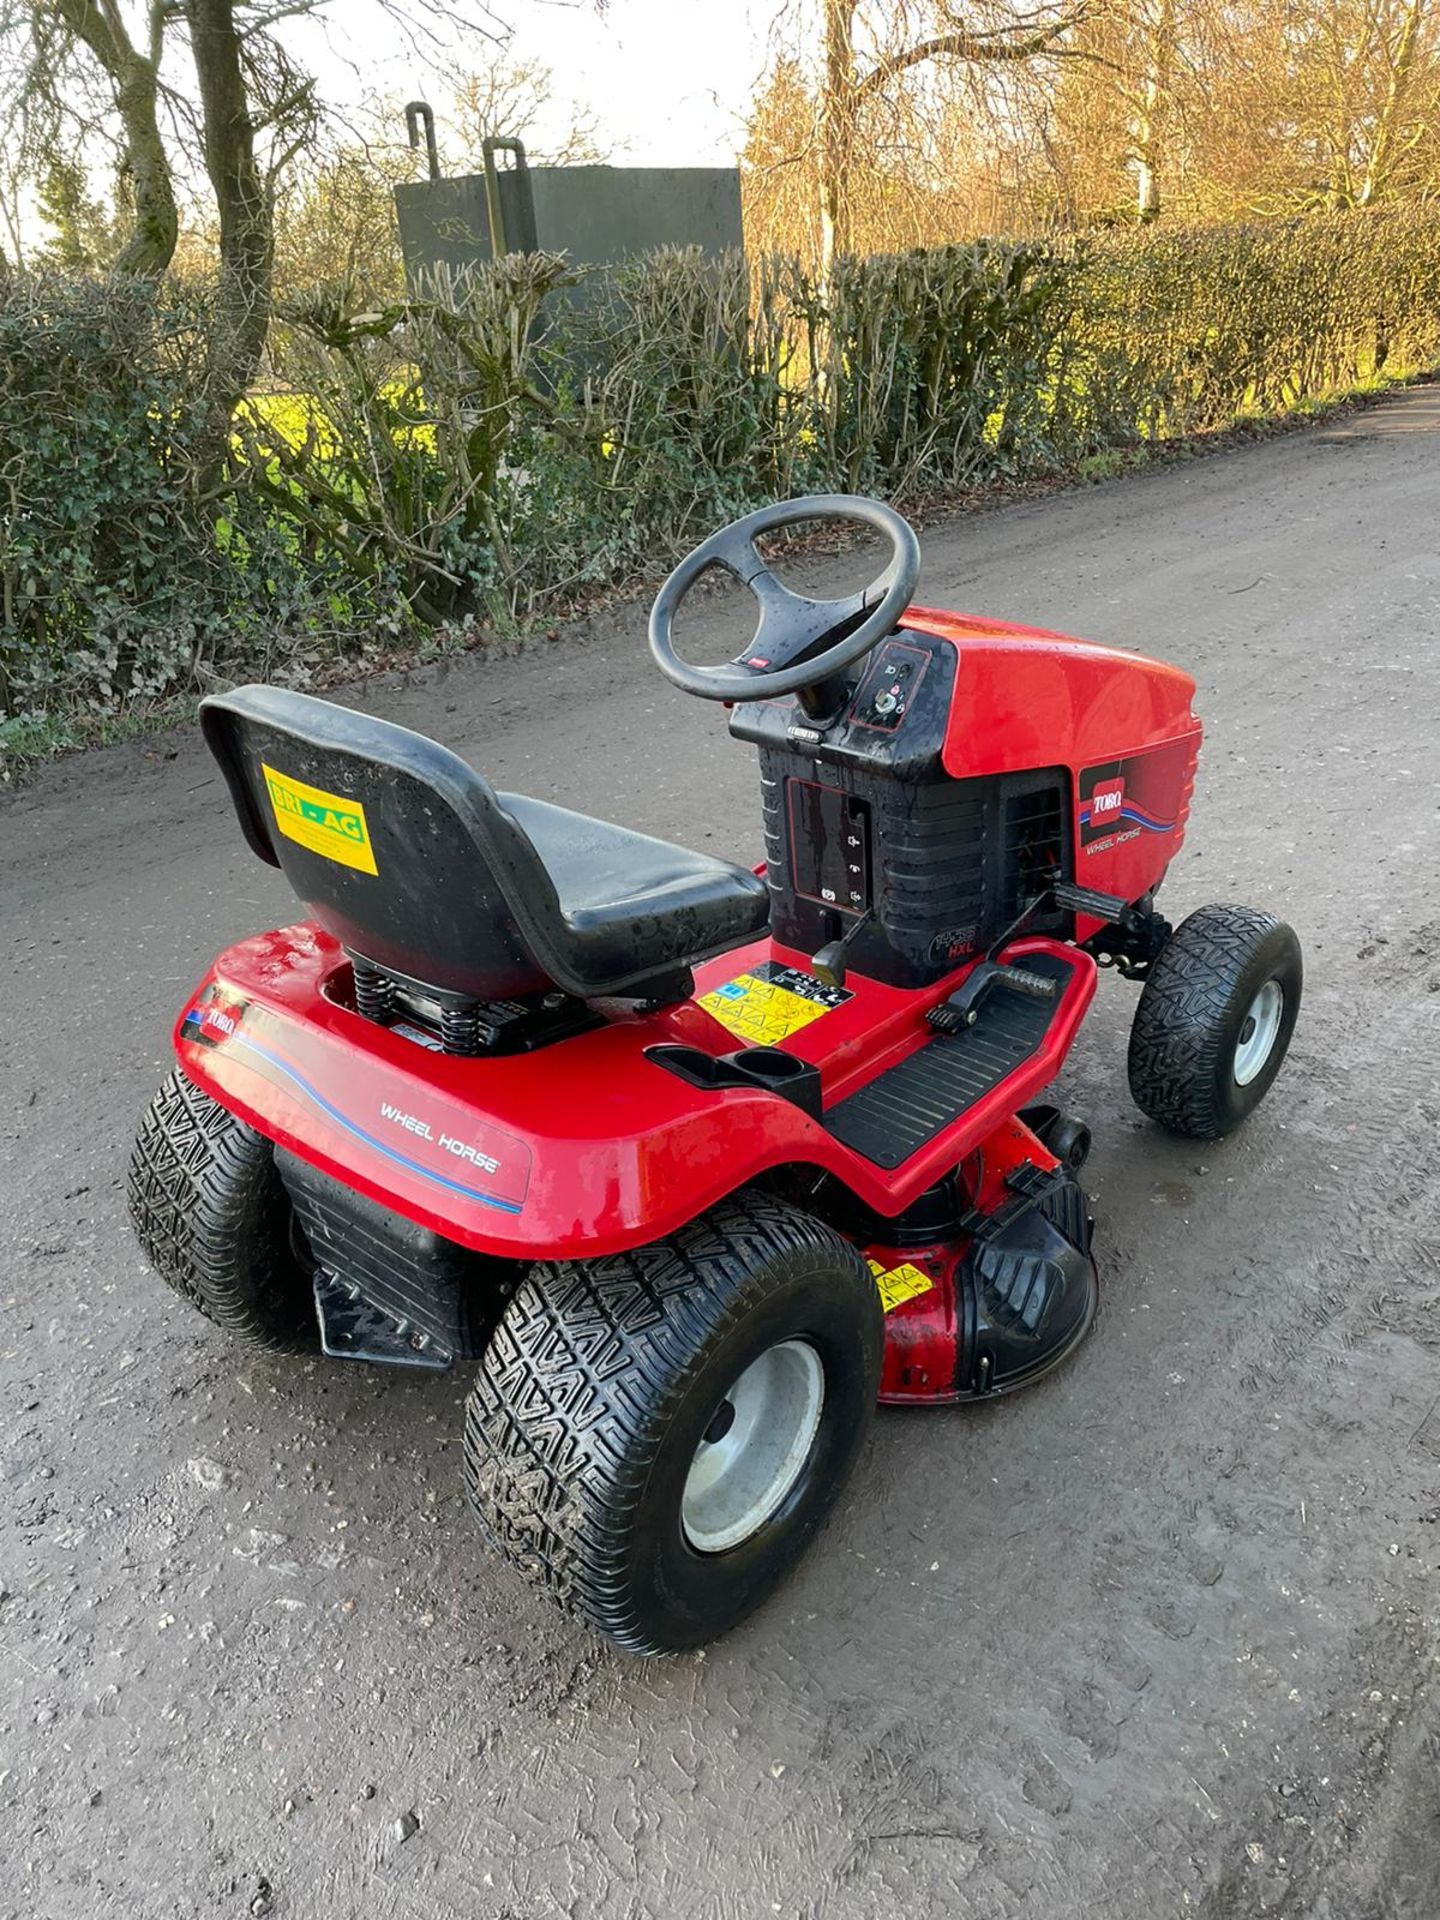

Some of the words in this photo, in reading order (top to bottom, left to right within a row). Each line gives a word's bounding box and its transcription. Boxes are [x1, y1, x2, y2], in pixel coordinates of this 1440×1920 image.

[1094, 790, 1121, 814] TORO
[324, 809, 362, 839] AG
[1086, 838, 1115, 856] WHEEL
[207, 1008, 235, 1035] TORO
[380, 1102, 435, 1142] WHEEL
[438, 1133, 500, 1174] HORSE
